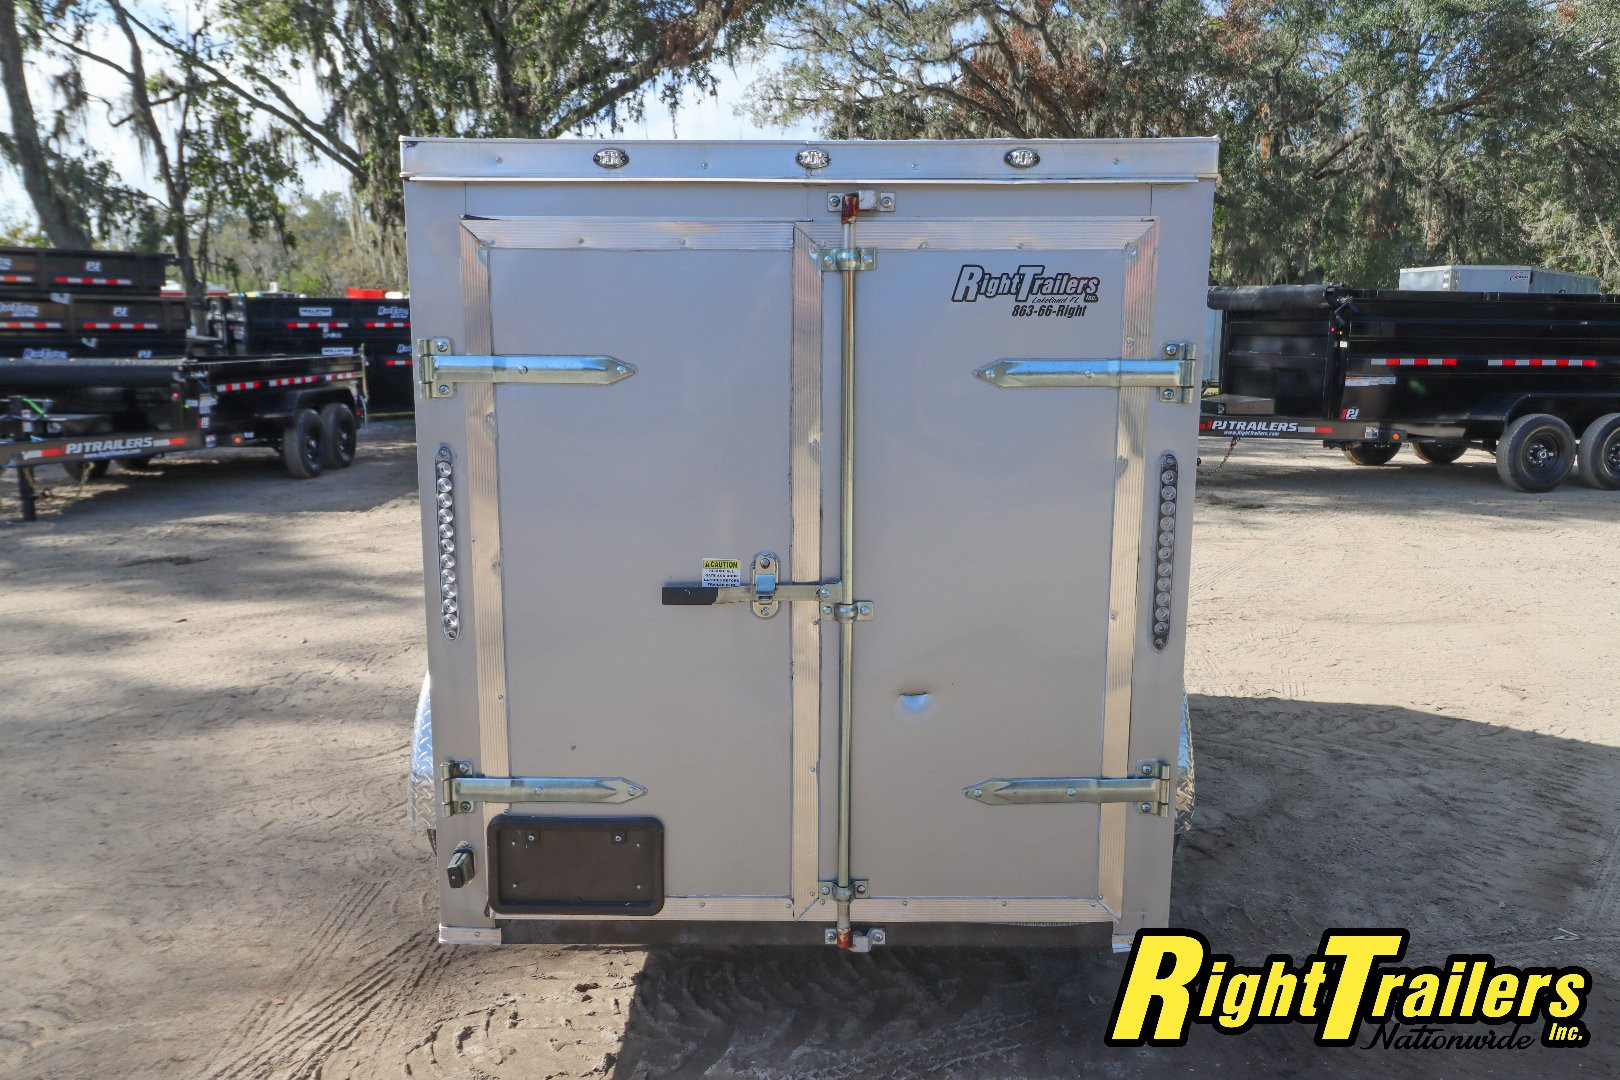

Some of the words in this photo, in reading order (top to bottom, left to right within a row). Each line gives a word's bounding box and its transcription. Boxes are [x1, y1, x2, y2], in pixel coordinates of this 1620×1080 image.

[1011, 304, 1088, 319] 863-66-Right
[1346, 408, 1359, 420] PJ
[1228, 421, 1299, 432] TRAILERS
[83, 437, 154, 453] TRAILERS
[710, 561, 738, 569] CAUTION
